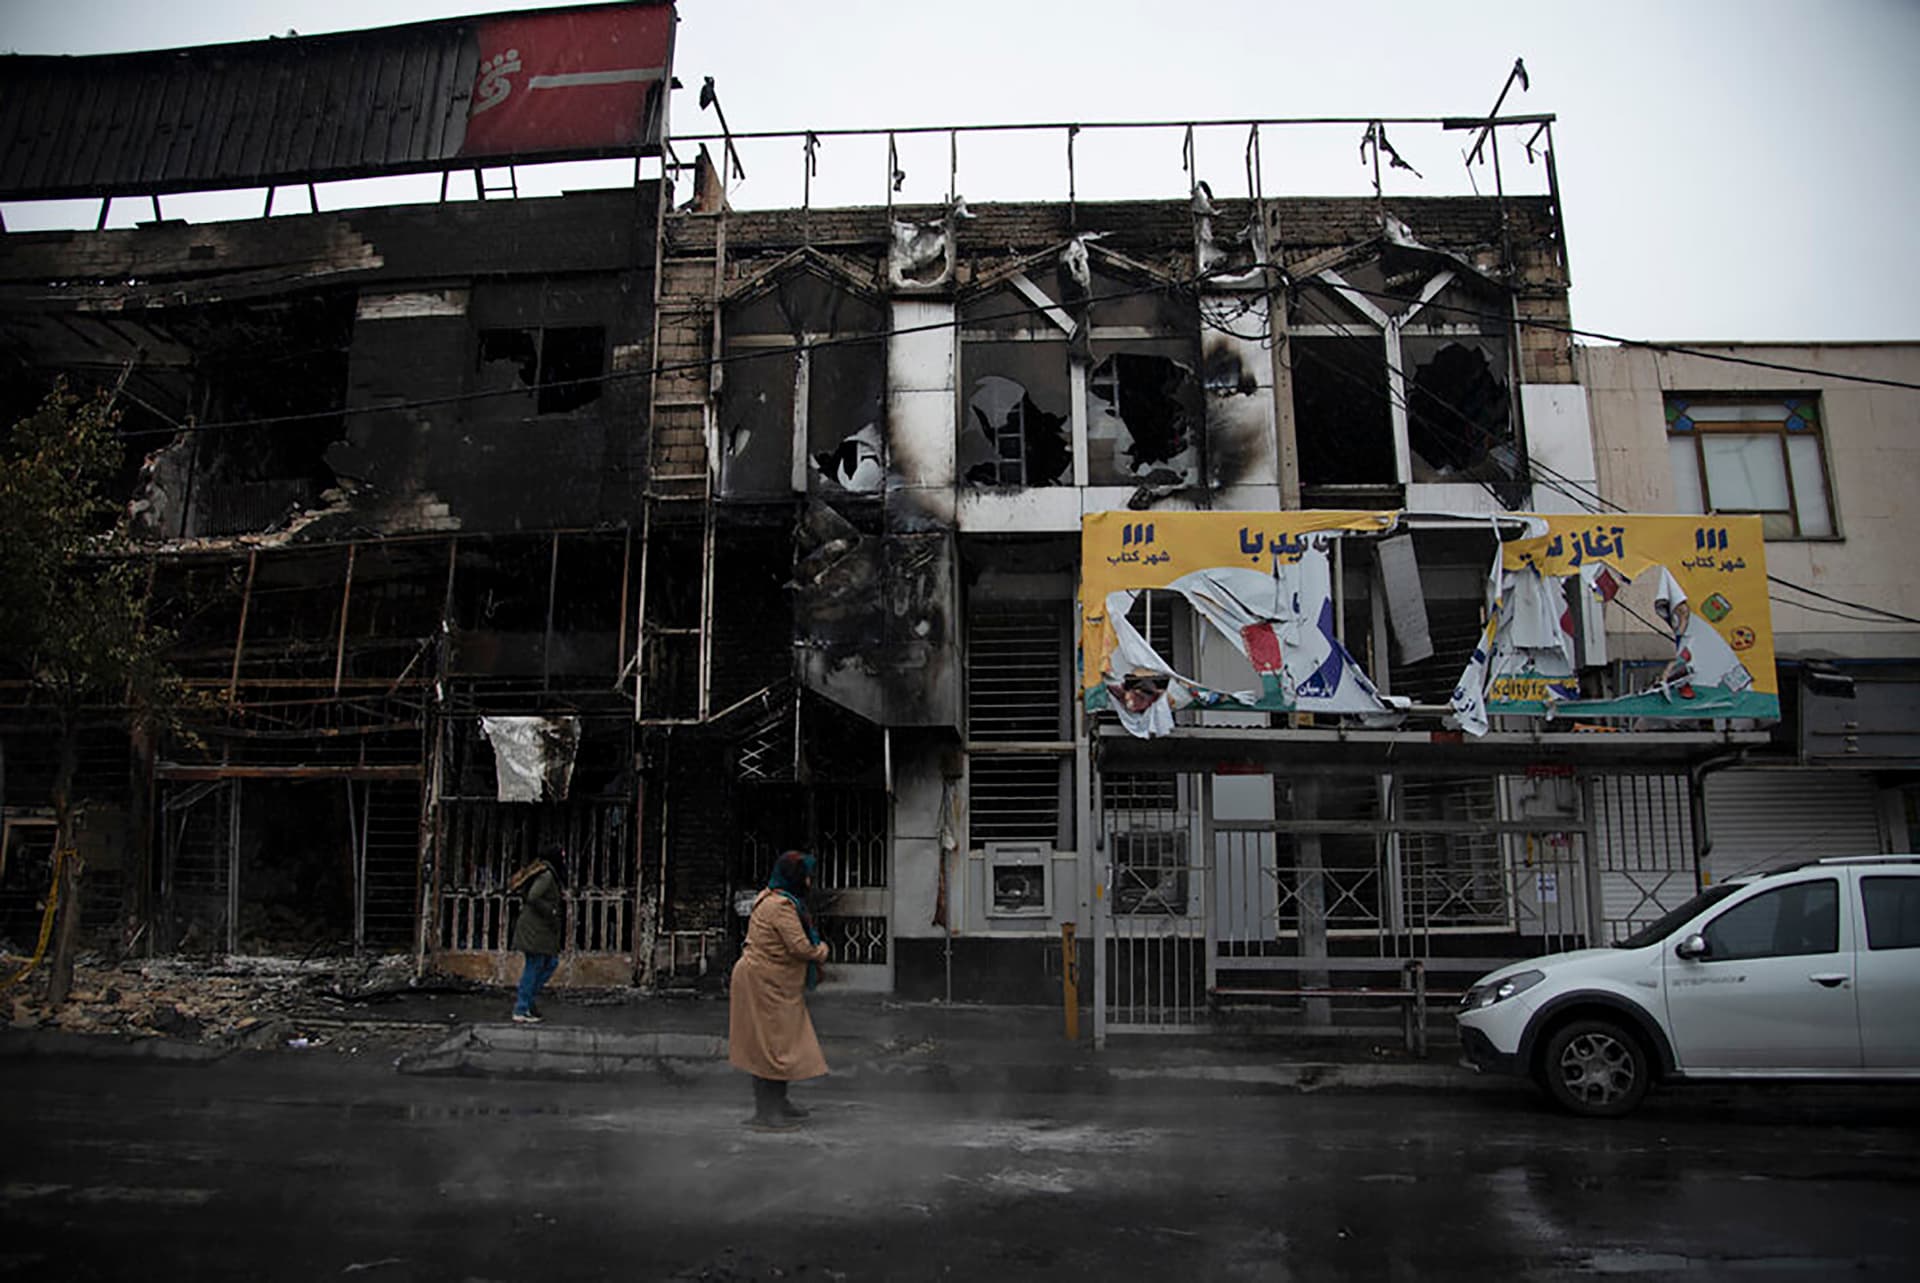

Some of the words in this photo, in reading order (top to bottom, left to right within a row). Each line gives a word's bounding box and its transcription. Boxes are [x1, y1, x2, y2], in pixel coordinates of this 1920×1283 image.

[1239, 528, 1264, 563] با
[1569, 526, 1625, 566] آغاز
[1106, 549, 1141, 565] کتاب
[1143, 550, 1170, 565] شهر
[1681, 556, 1715, 572] کتاب
[1718, 556, 1746, 572] شهر
